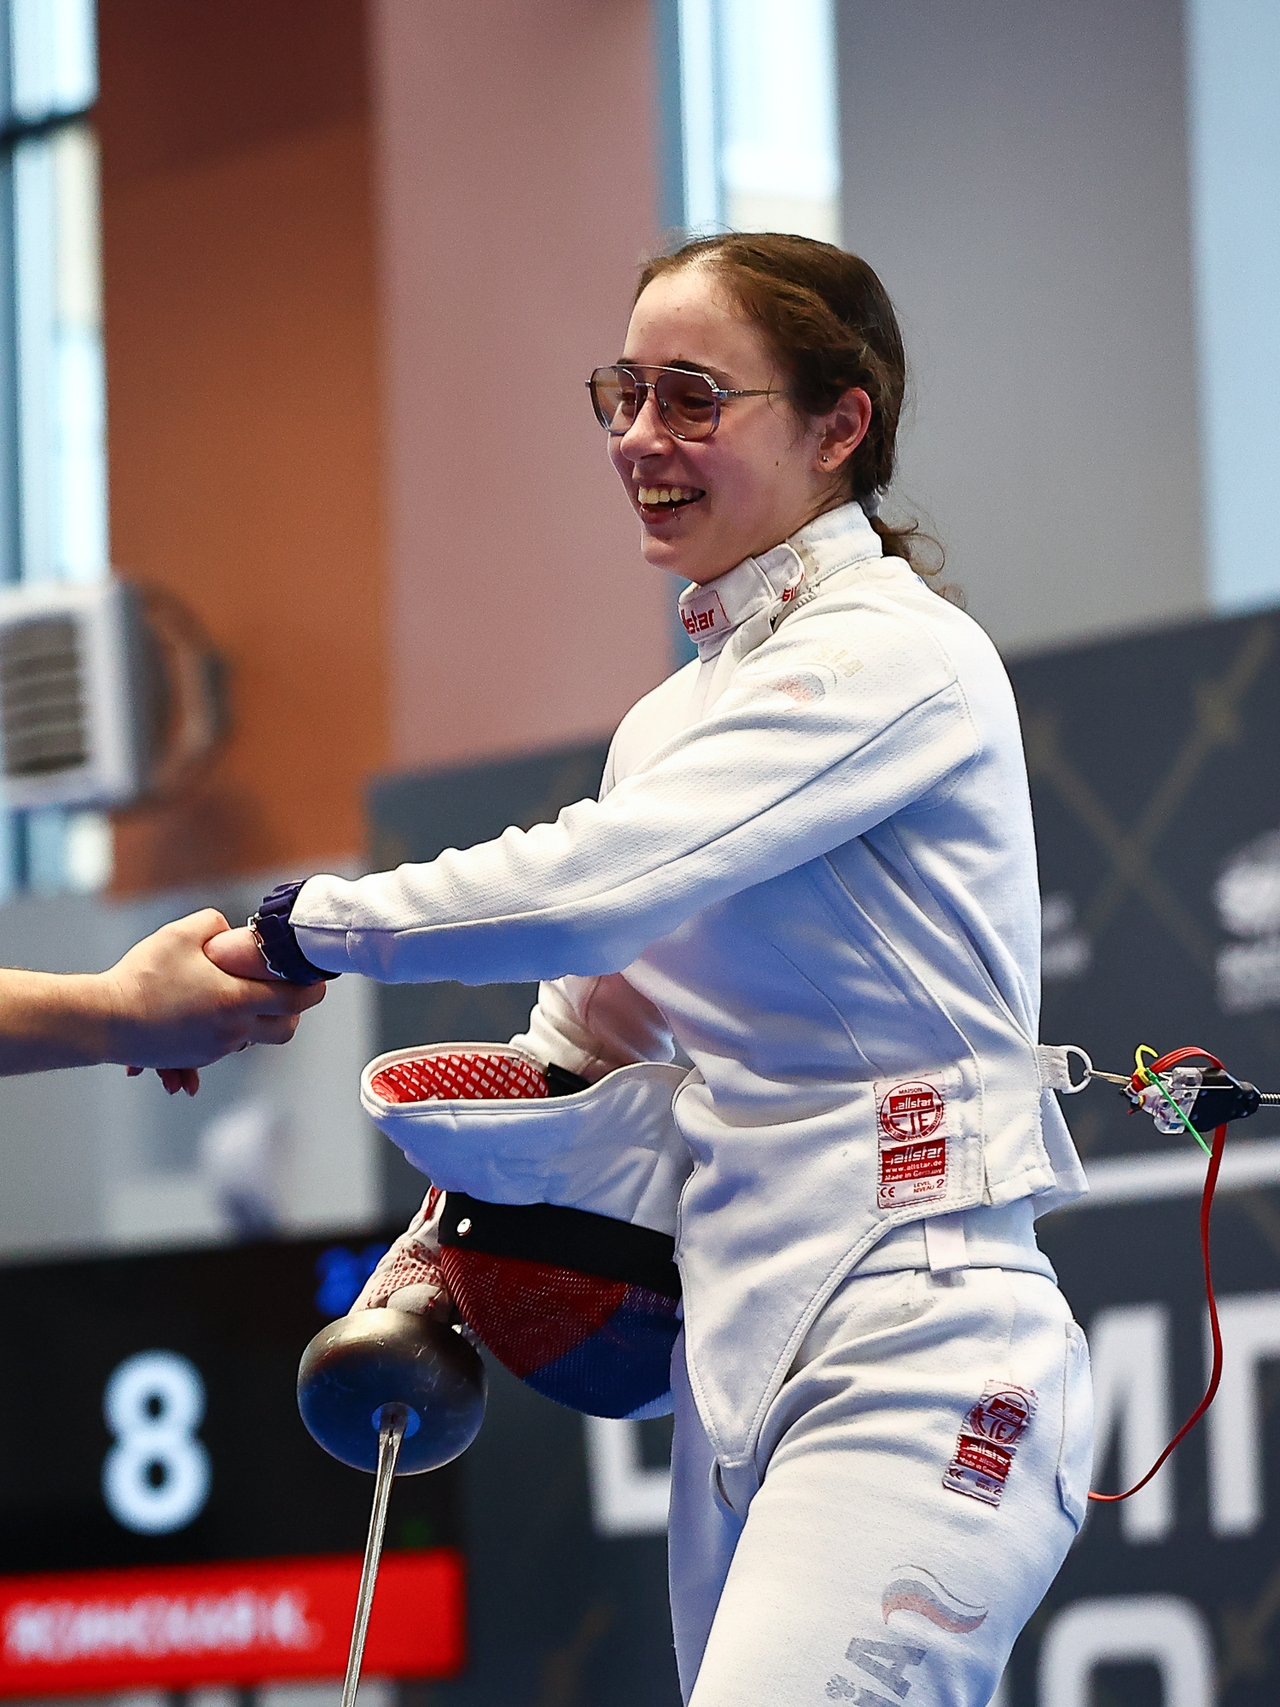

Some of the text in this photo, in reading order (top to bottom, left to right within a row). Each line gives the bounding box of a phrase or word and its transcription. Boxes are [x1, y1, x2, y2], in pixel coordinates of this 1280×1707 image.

[893, 1097, 931, 1111] allstar
[885, 1145, 943, 1165] allstar
[885, 1160, 943, 1173] www.allstar.de
[936, 1178, 945, 1189] 2
[102, 1348, 214, 1537] 8
